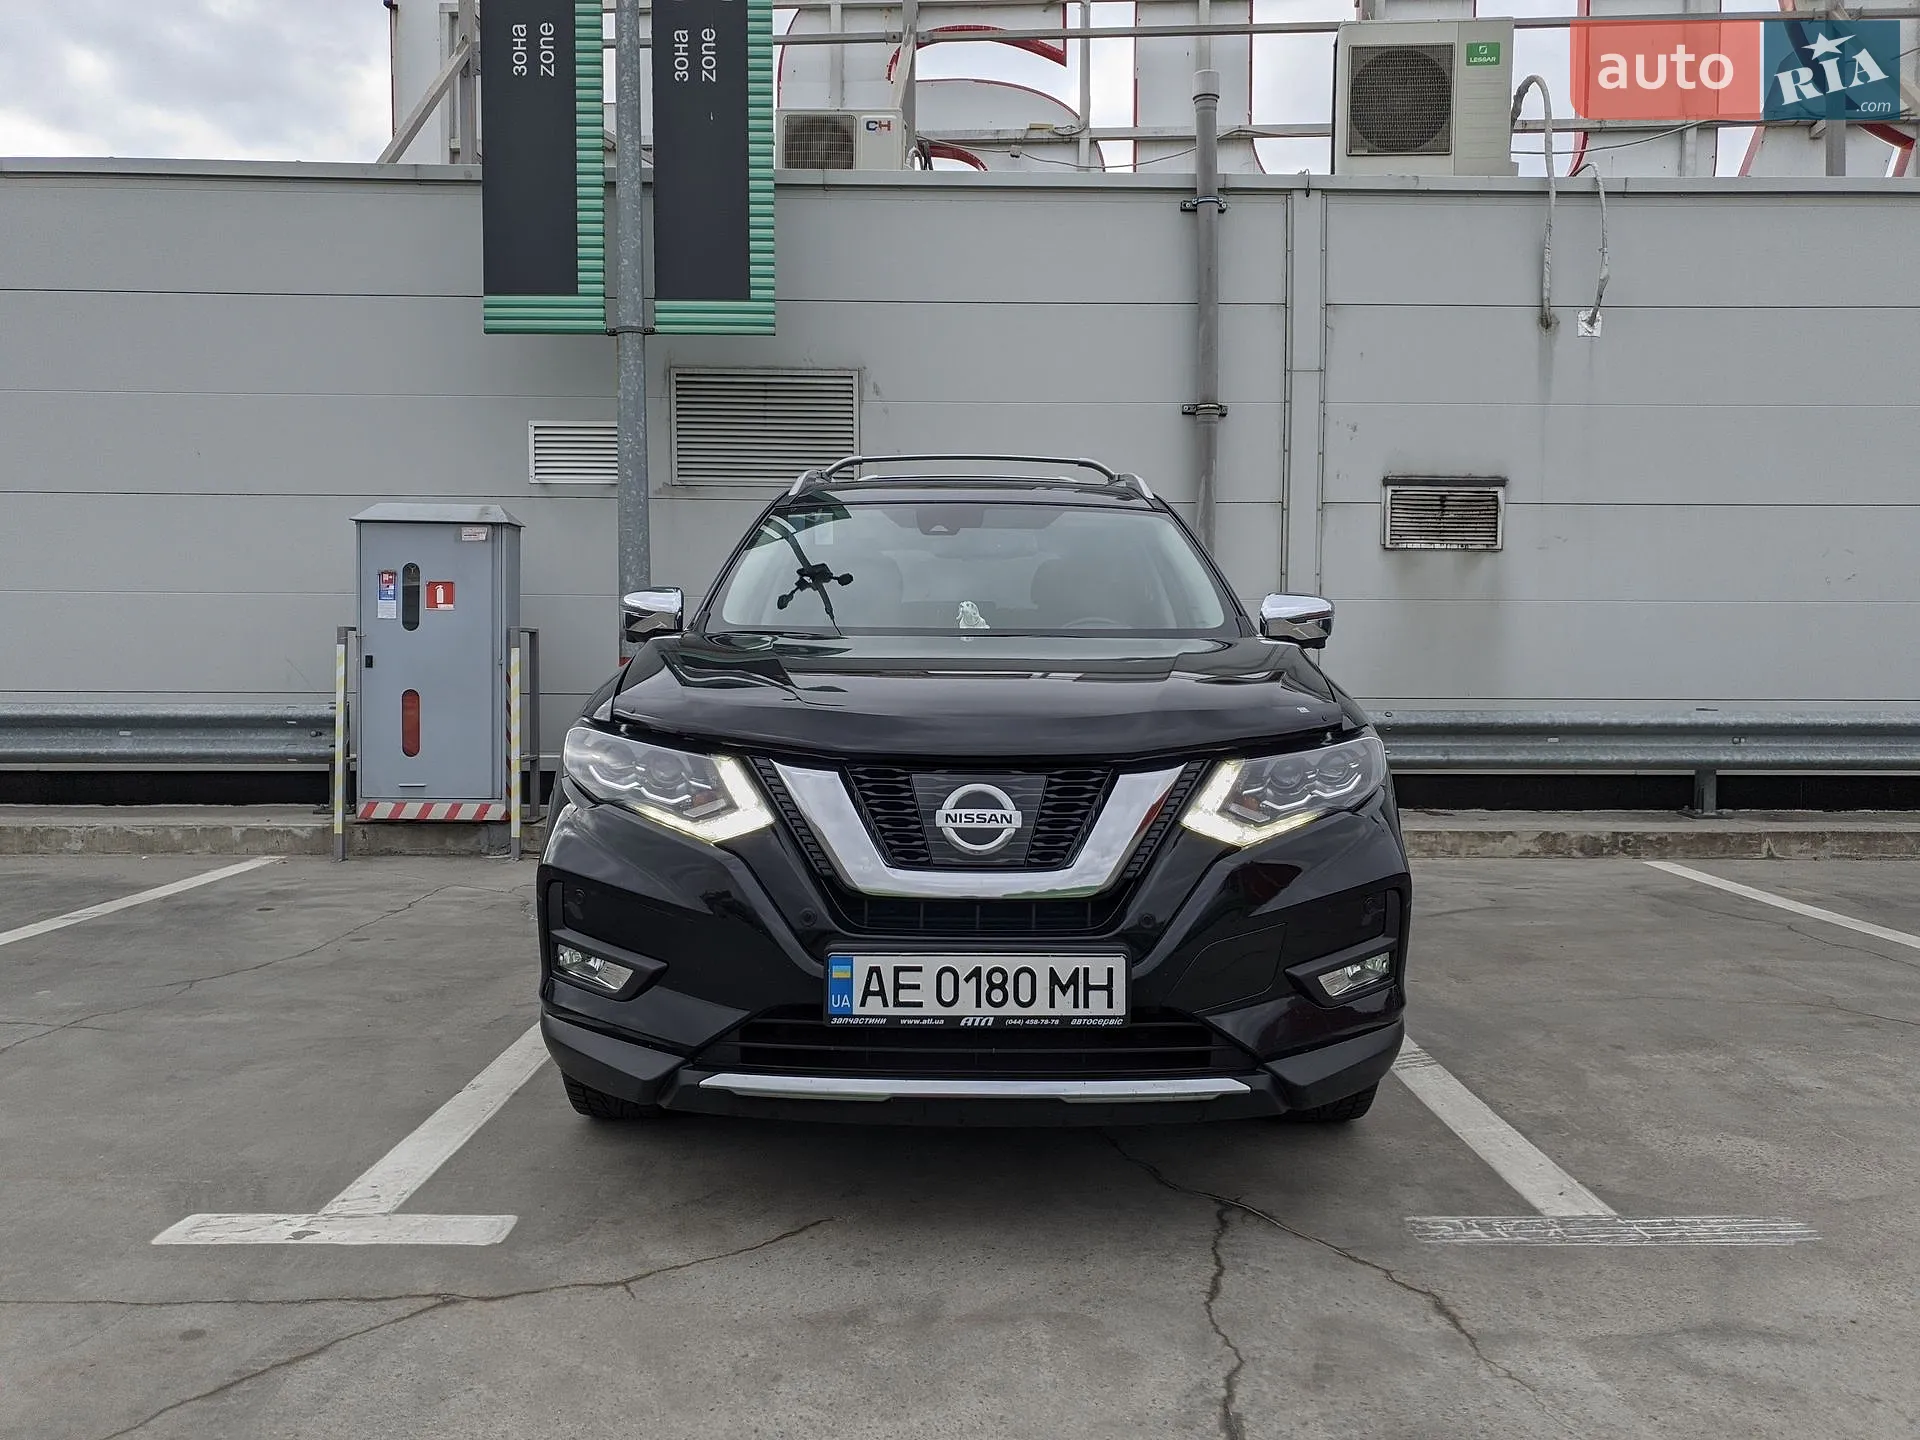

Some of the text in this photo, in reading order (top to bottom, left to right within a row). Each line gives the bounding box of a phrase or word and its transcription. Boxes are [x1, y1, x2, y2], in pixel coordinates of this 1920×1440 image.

[512, 24, 527, 76] зона
[540, 22, 555, 77] zone
[674, 29, 689, 82] зона
[702, 28, 716, 82] zone
[866, 120, 891, 131] CH
[945, 813, 1013, 824] NISSAN
[831, 994, 851, 1008] UA
[859, 965, 1114, 1008] AE 0180 MH
[831, 1017, 887, 1025] запчастини
[1070, 1017, 1123, 1027] автосервіс
